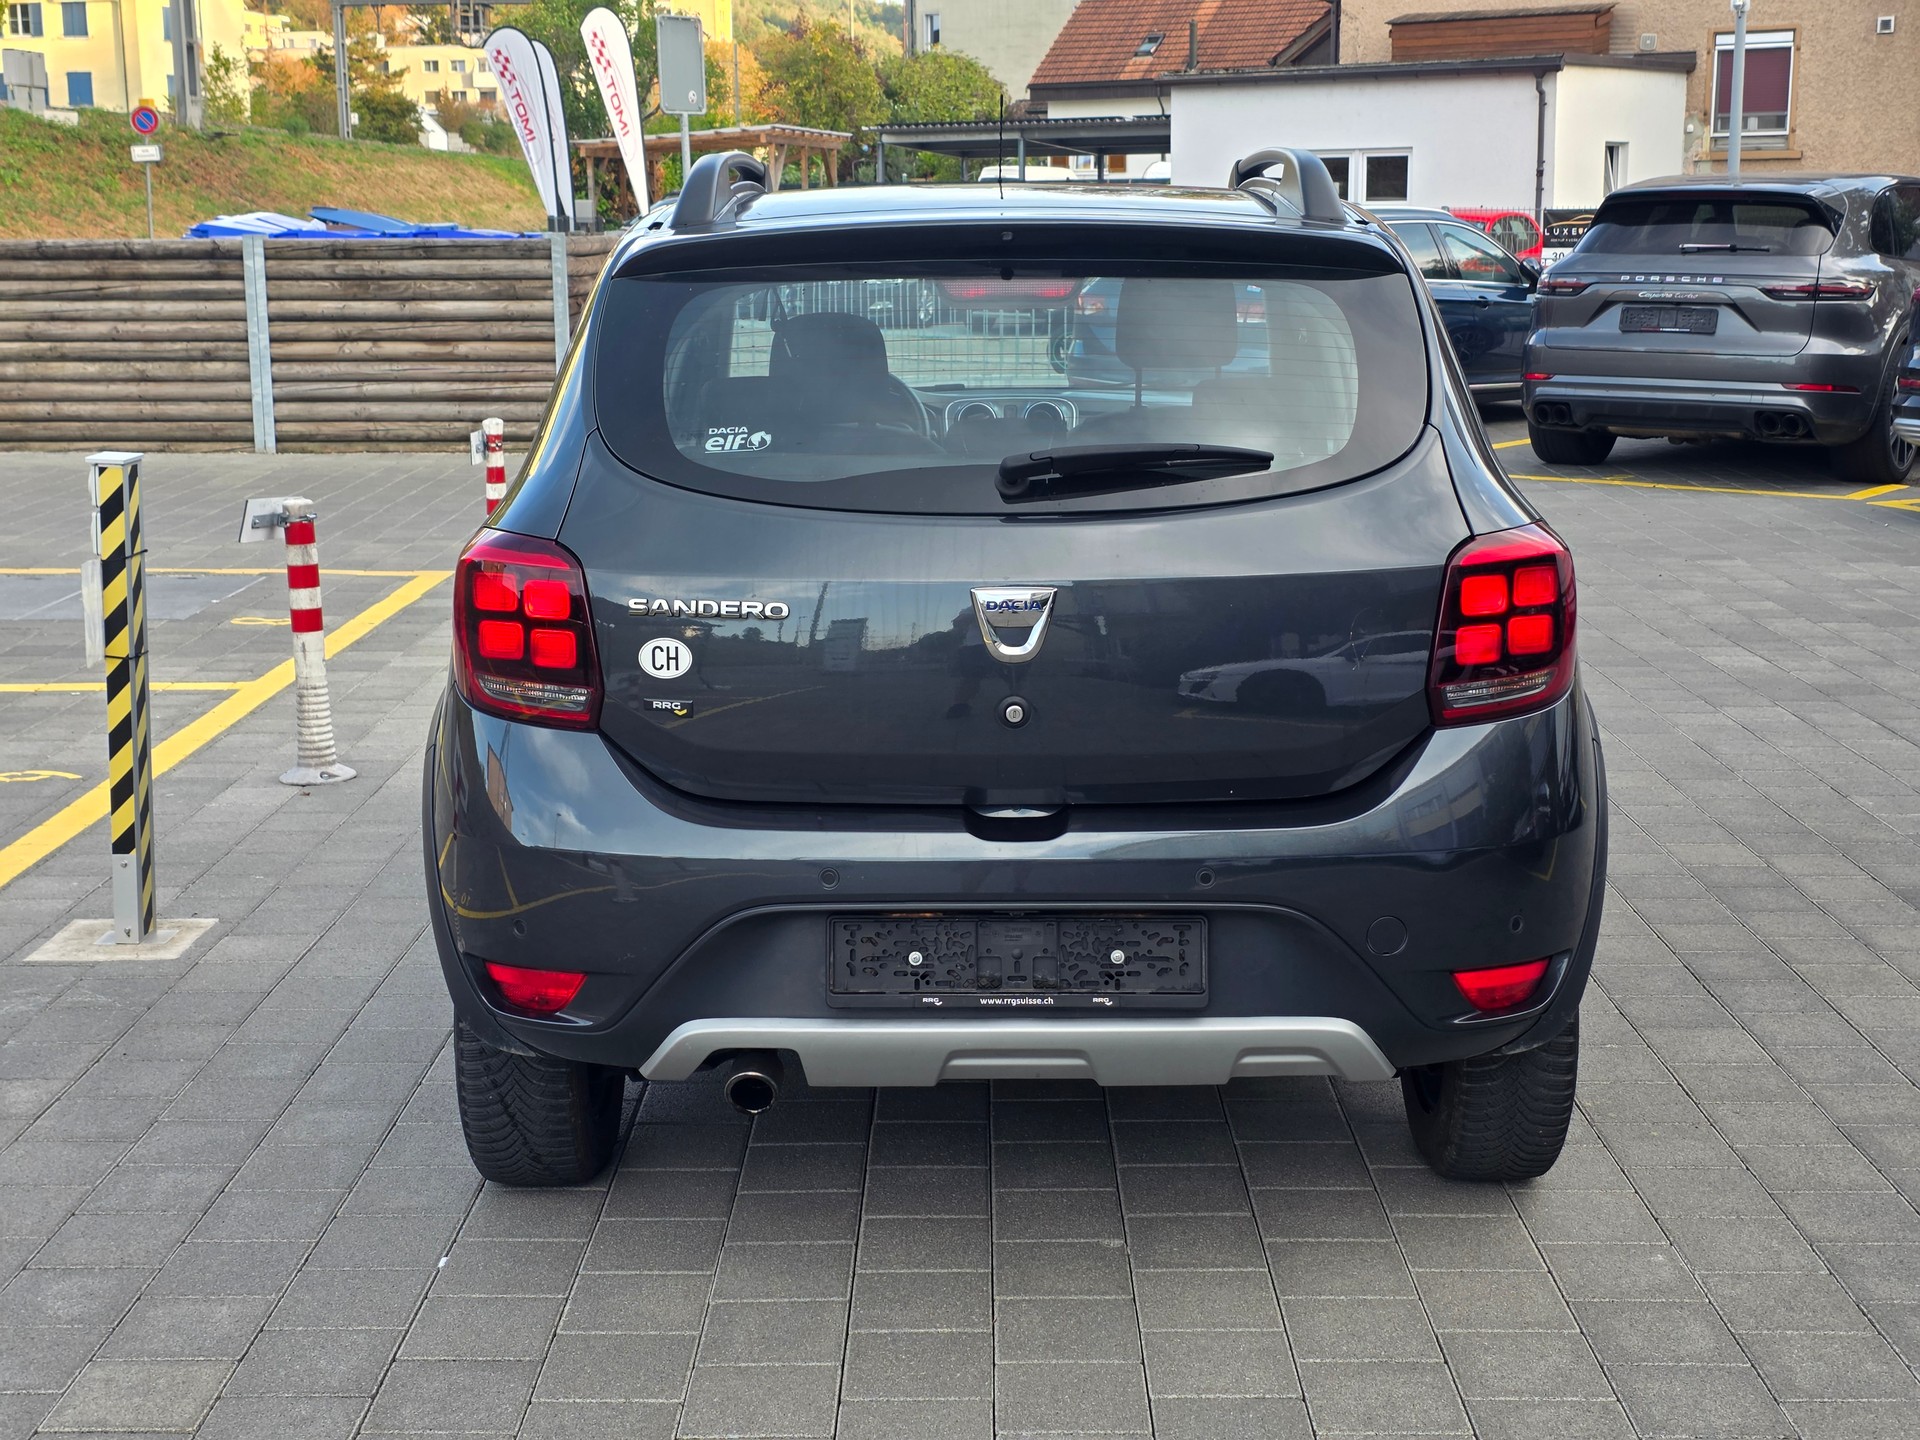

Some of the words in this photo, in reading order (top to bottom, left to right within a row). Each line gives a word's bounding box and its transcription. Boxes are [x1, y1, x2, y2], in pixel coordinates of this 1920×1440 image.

[606, 75, 630, 137] TOMI
[511, 86, 536, 142] TOMI
[1621, 275, 1723, 283] PORSCHE
[708, 426, 748, 435] DACIA
[704, 433, 748, 451] elf
[628, 598, 790, 619] SANDERO
[986, 600, 1042, 612] DACIA
[651, 645, 679, 671] CH
[652, 701, 681, 710] RRG
[980, 997, 1054, 1005] www.rrgsuisse.ch
